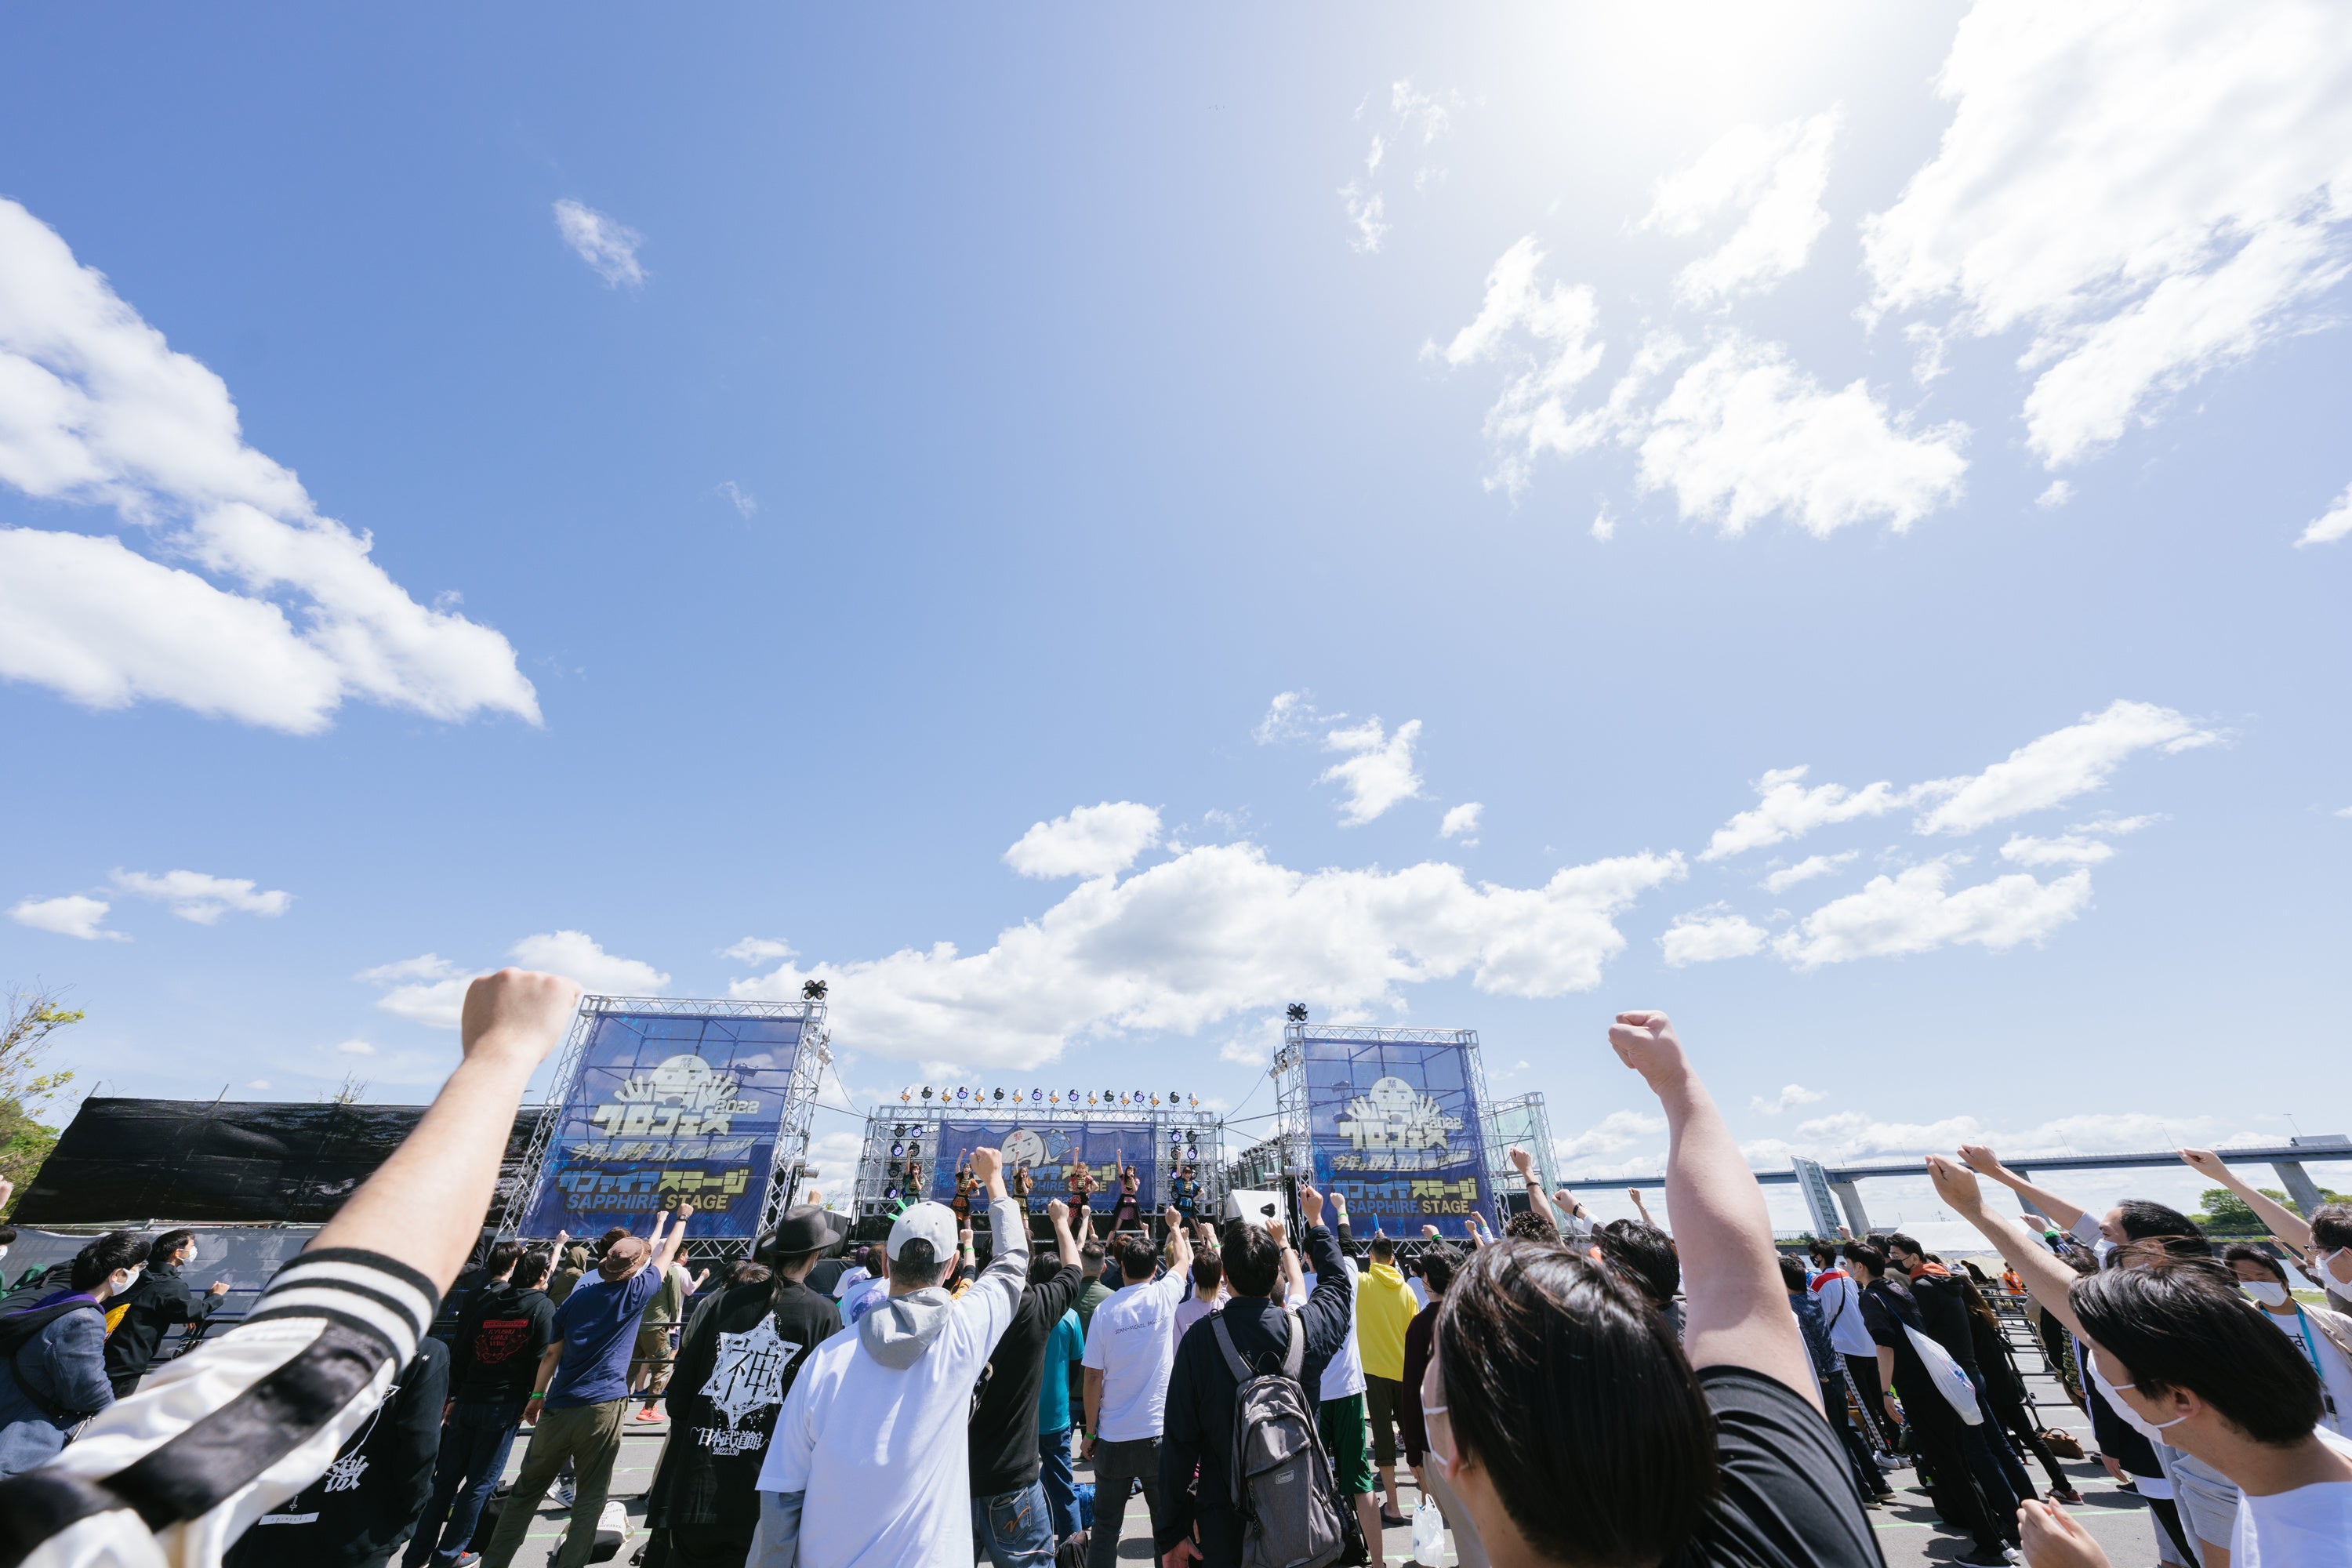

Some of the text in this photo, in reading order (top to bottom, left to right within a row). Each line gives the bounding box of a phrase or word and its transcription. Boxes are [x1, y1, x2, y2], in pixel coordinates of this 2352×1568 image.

[714, 1099, 760, 1114] 2022
[593, 1105, 732, 1136] クロフェス
[1425, 1116, 1463, 1130] 2022
[1339, 1122, 1448, 1149] クロフェス
[557, 1169, 750, 1193] サファイアステージ
[1007, 1181, 1065, 1191] SPHIRE
[1334, 1178, 1477, 1200] サファイアステージ
[566, 1194, 728, 1210] SAPPHIRE STAGE
[1347, 1200, 1470, 1214] SAPPHIRE STAGE
[698, 1428, 764, 1451] 日本武道館
